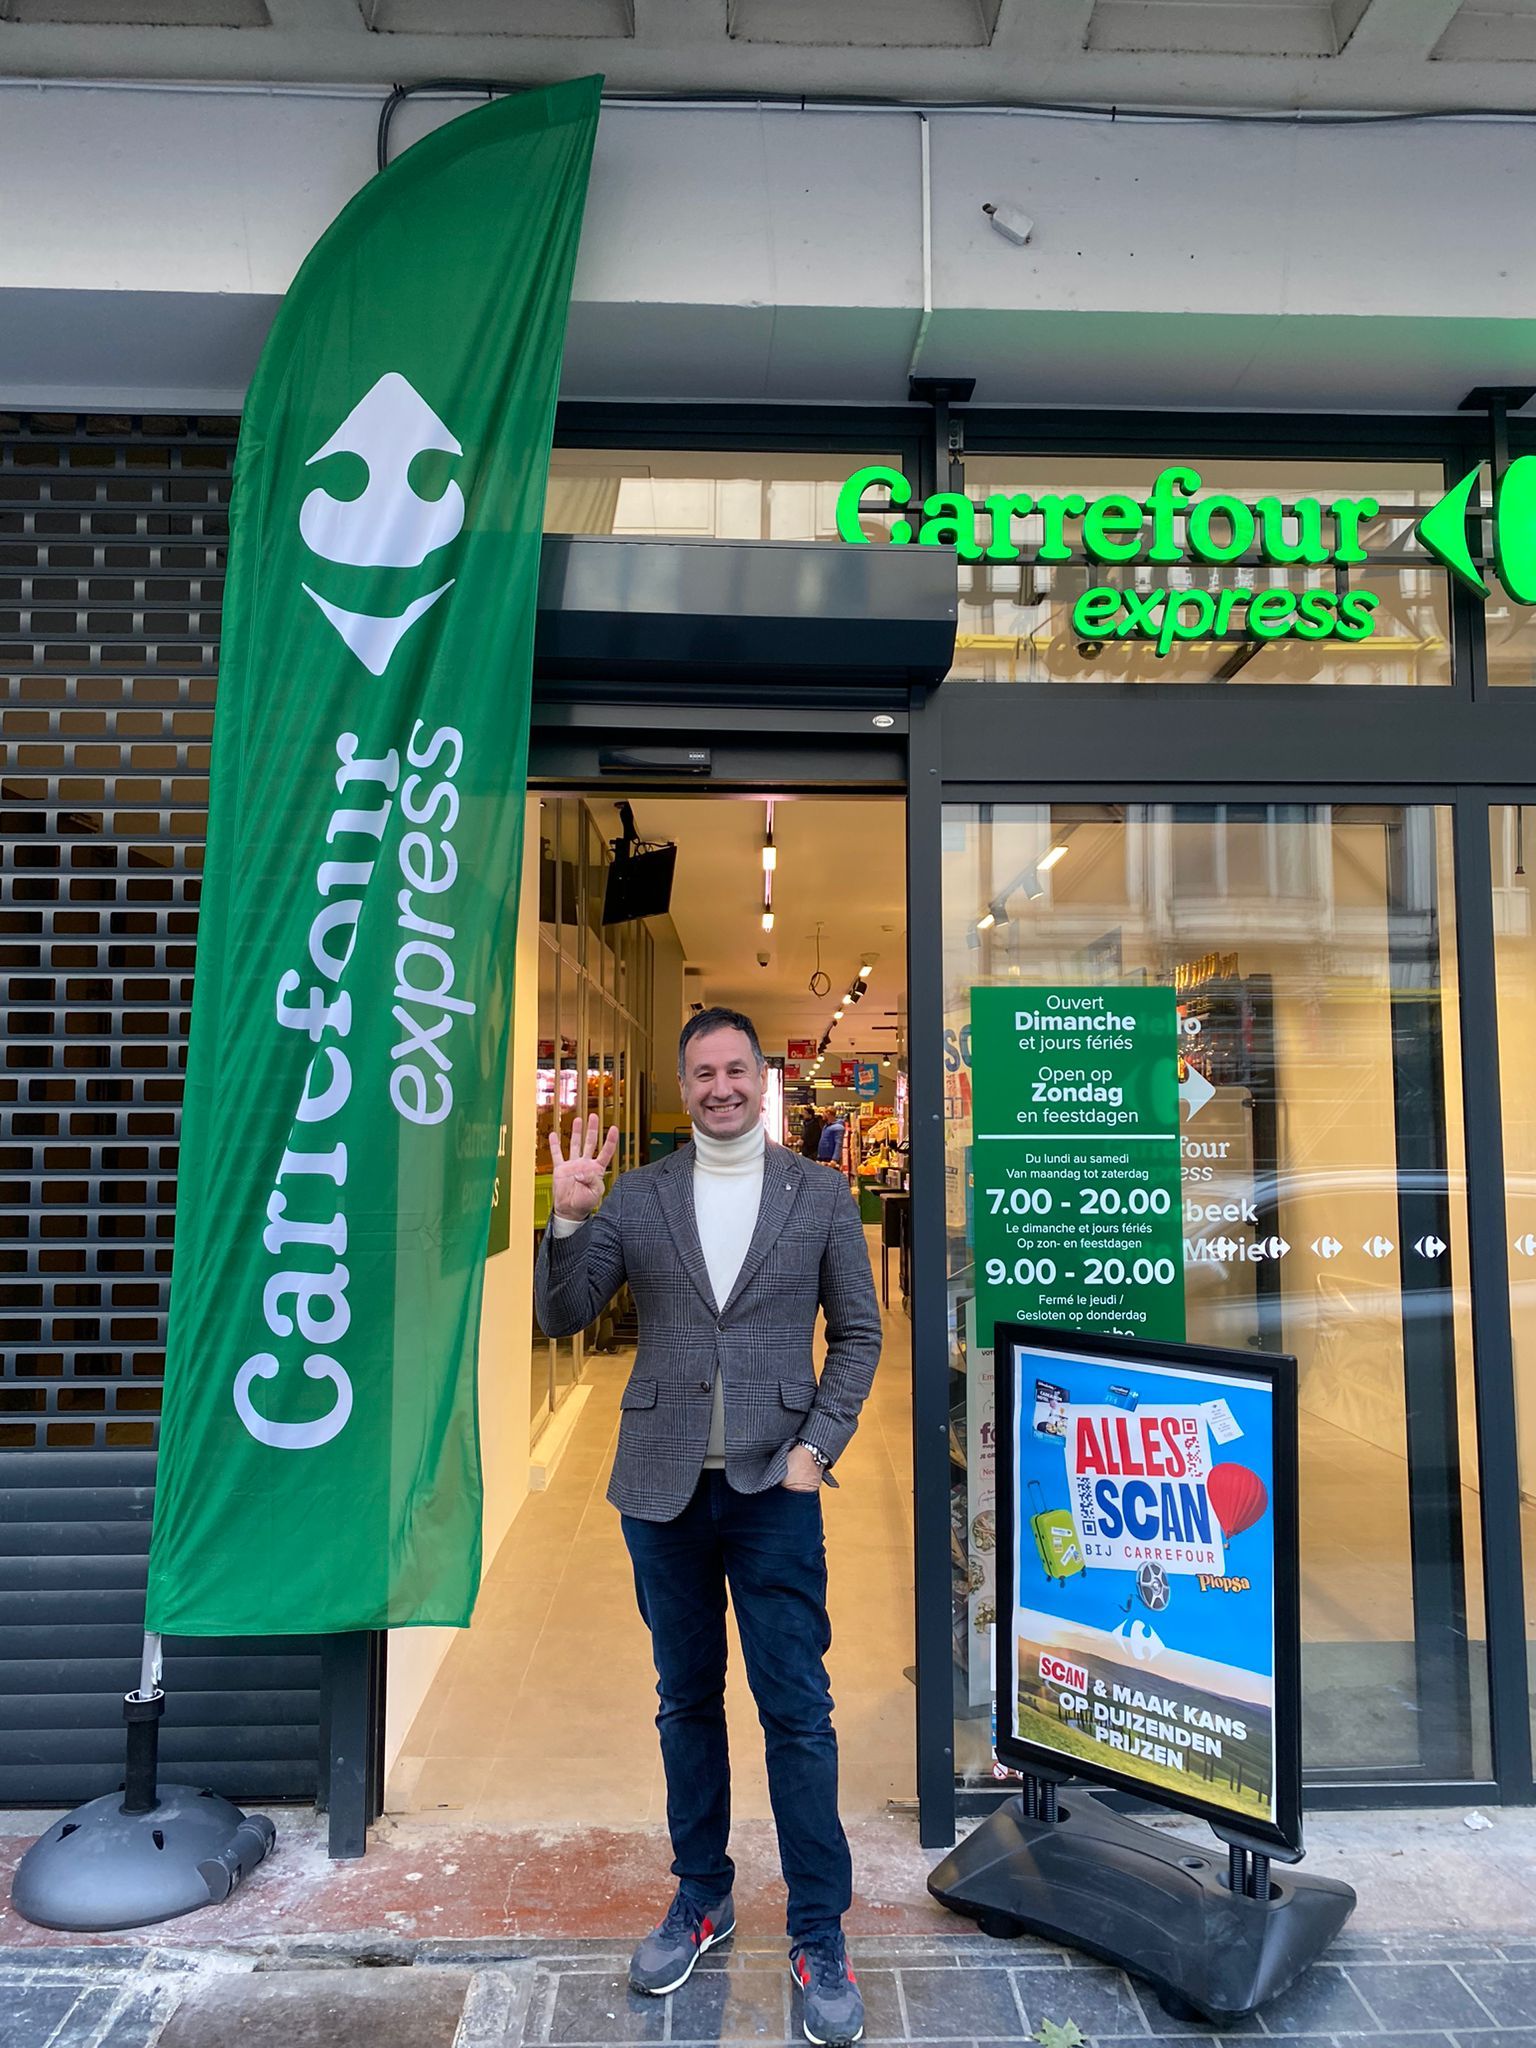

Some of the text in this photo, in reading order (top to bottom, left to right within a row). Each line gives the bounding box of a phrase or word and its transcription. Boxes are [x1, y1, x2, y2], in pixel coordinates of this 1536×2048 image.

[836, 465, 1379, 563] Carrefour
[1073, 585, 1379, 658] express
[390, 719, 476, 1125] express
[1046, 995, 1104, 1010] Ouvert
[1015, 1010, 1136, 1031] Dimanche
[1018, 1035, 1133, 1053] et jours fériés
[1038, 1066, 1113, 1084] Open op
[1031, 1083, 1123, 1107] Zondag
[1016, 1108, 1138, 1126] en feestdagen
[1025, 1153, 1129, 1164] Du lundi au samedi
[1006, 1168, 1149, 1181] Van maandag tot zaterdag
[986, 1188, 1052, 1215] 7.00
[1079, 1188, 1171, 1215] 20.00
[1006, 1222, 1152, 1235] Le dimanche et jours fériés
[1017, 1238, 1034, 1250] Op
[1036, 1240, 1060, 1248] zon-
[1063, 1240, 1077, 1248] en
[1080, 1238, 1142, 1250] feestdagen
[985, 1258, 1056, 1285] 9.00
[1083, 1258, 1175, 1285] 20.00
[1039, 1294, 1074, 1305] Fermé
[1077, 1295, 1087, 1305] le
[1089, 1295, 1117, 1307] jeudi
[1016, 1310, 1147, 1322] Gesloten op donderdag
[1076, 1417, 1187, 1478] ALLES
[1095, 1479, 1212, 1544] SCAN
[1085, 1544, 1112, 1557] BIJ
[1124, 1546, 1215, 1563] CARREFOUR
[1198, 1574, 1250, 1593] Plopsa
[1041, 1656, 1247, 1740] SCAN & MAAK KANS
[1059, 1692, 1222, 1759] OP DUIZENDEN
[1095, 1725, 1183, 1771] PRIJZEN
